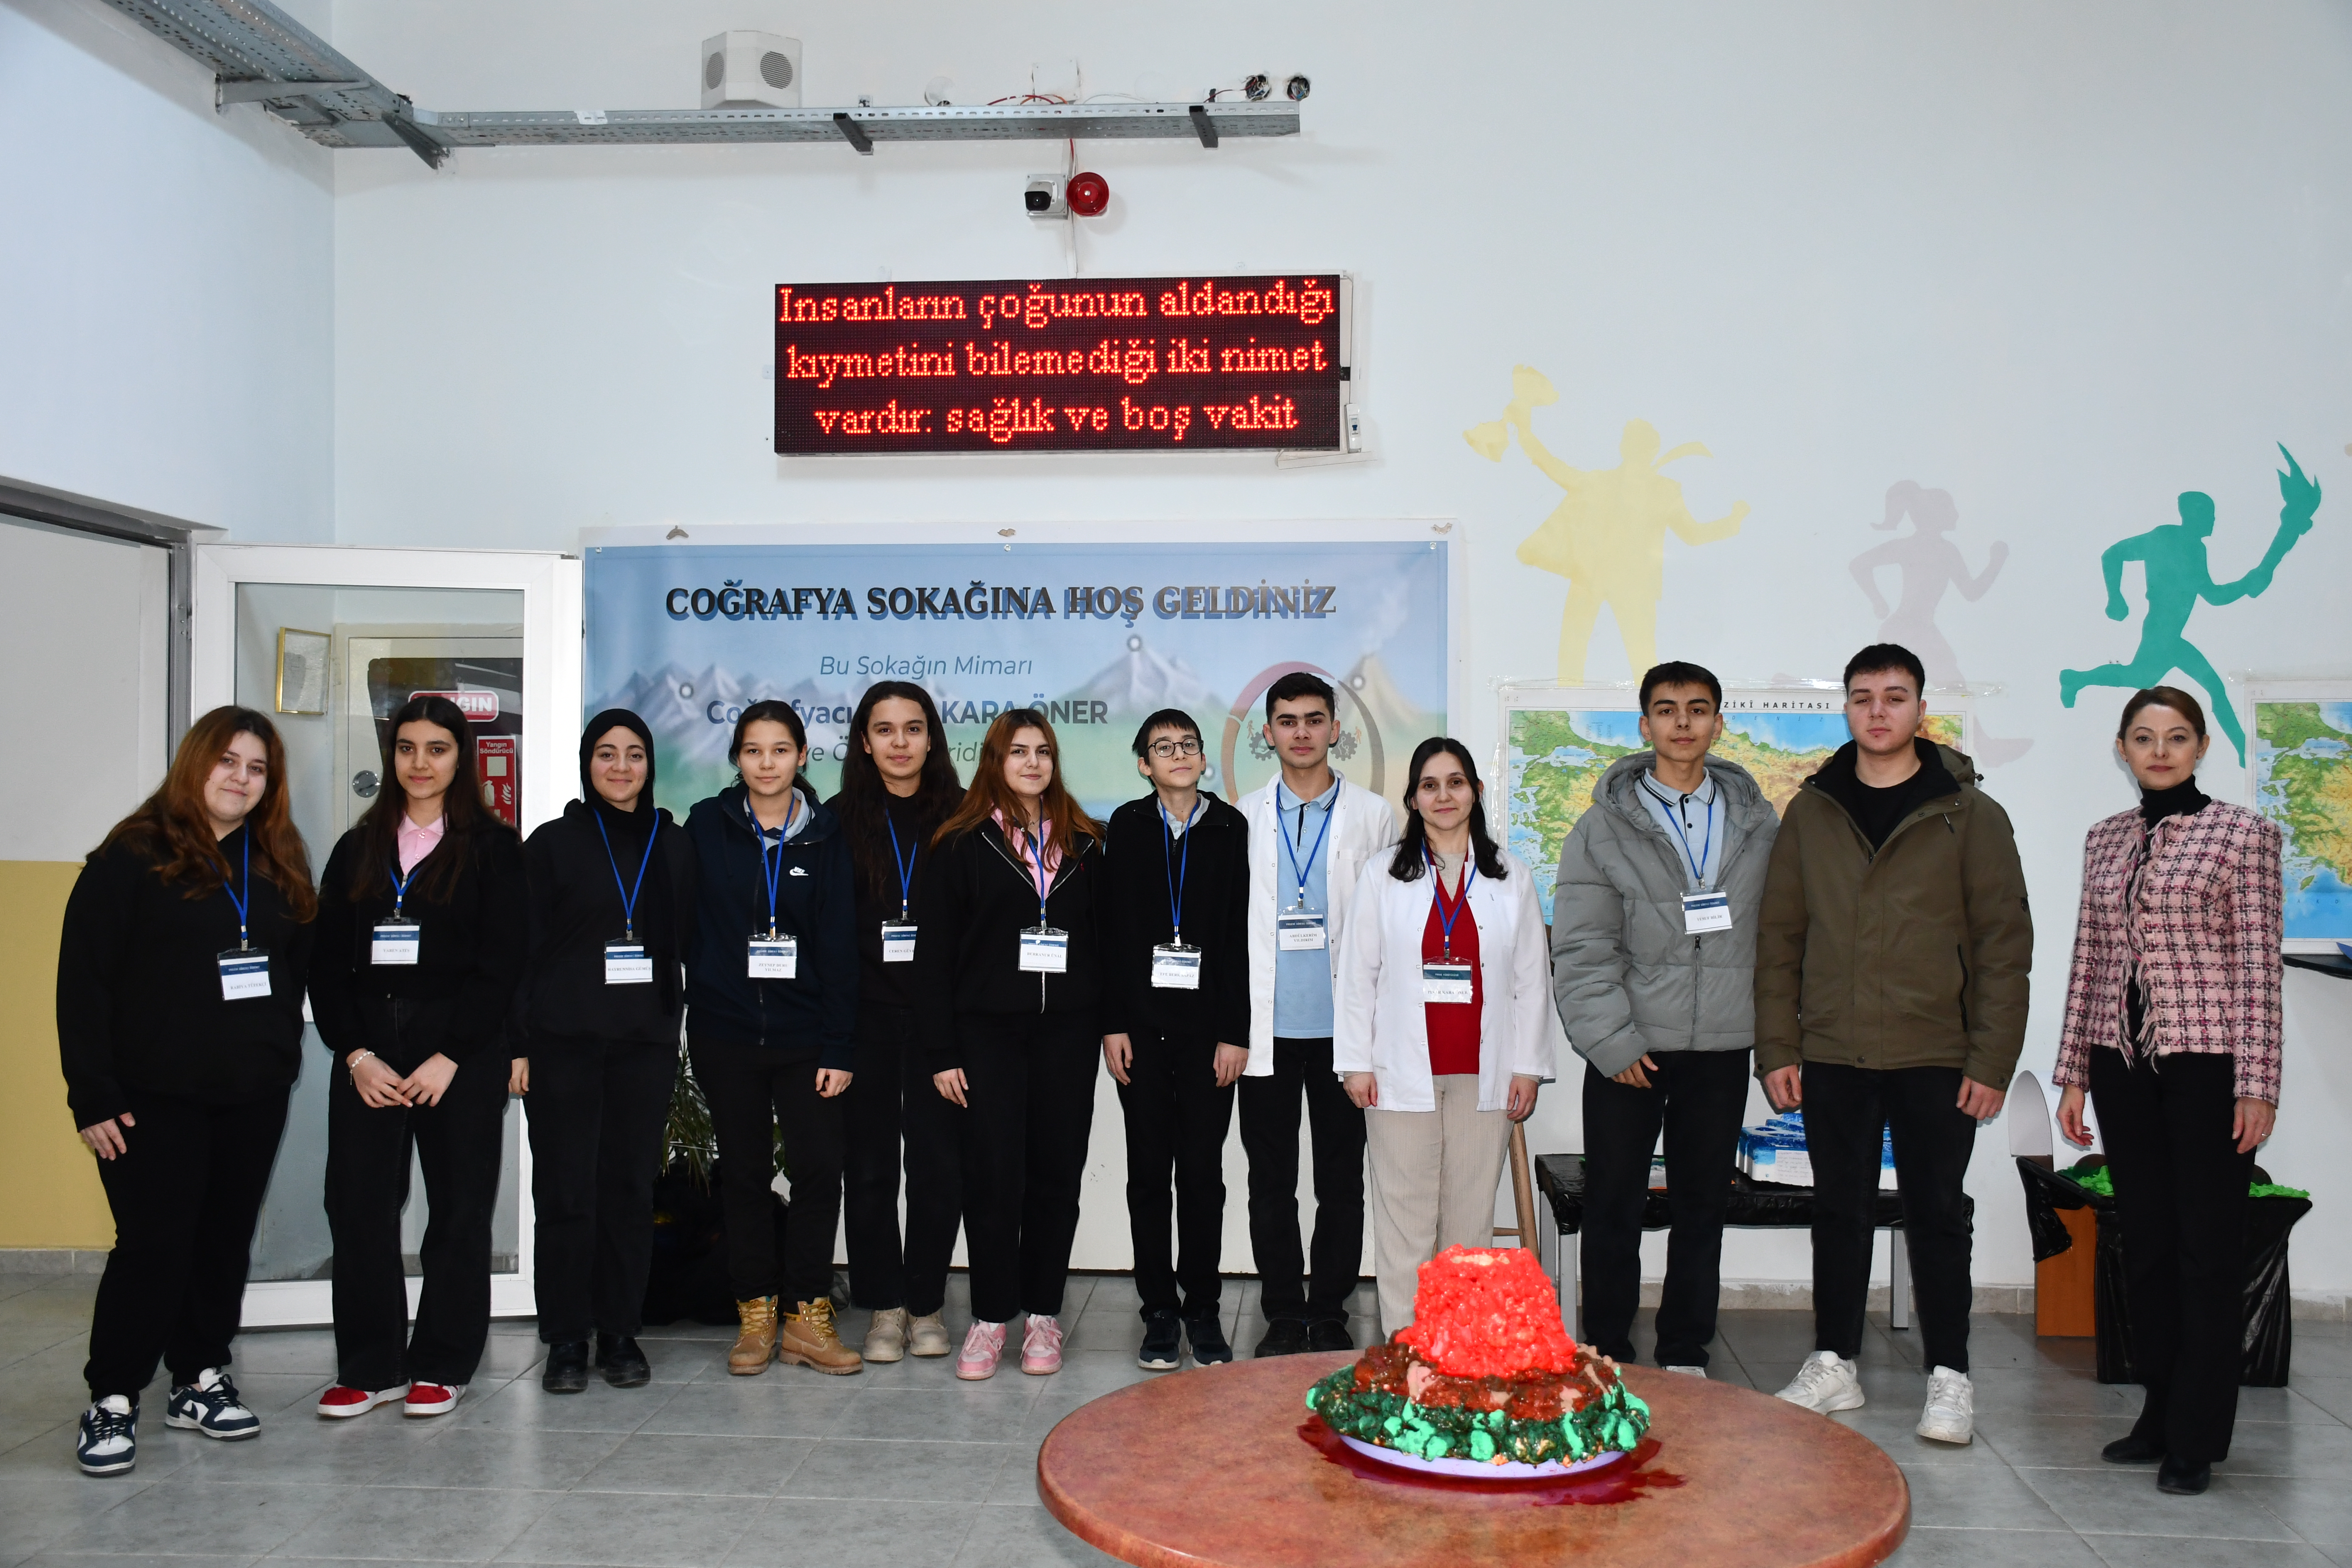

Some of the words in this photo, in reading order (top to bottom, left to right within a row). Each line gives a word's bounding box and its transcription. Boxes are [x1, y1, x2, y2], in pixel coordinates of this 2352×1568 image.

[979, 283, 1149, 329] çoğunun
[1160, 279, 1335, 325] aldandığı
[786, 341, 957, 389] kıymetini
[964, 339, 1159, 385] bilemediği
[1167, 338, 1213, 373] iki
[1220, 337, 1329, 373] nimet
[947, 397, 1056, 443] sağlık
[1063, 407, 1109, 432] ve
[1120, 396, 1192, 441] boş
[1203, 393, 1300, 430] vakit
[666, 579, 858, 620] COĞRAFYA
[867, 580, 1057, 619] SOKAĞINA
[1067, 586, 1144, 627] HOŞ
[1154, 579, 1337, 619] GELDİNİZ
[820, 655, 849, 675] Bu
[856, 655, 947, 680] Sokağın
[954, 655, 1032, 675] Mimarı
[707, 699, 852, 729] Cofyacı
[1028, 693, 1108, 724] ÖNER
[1763, 700, 1829, 709] HARİTASI
